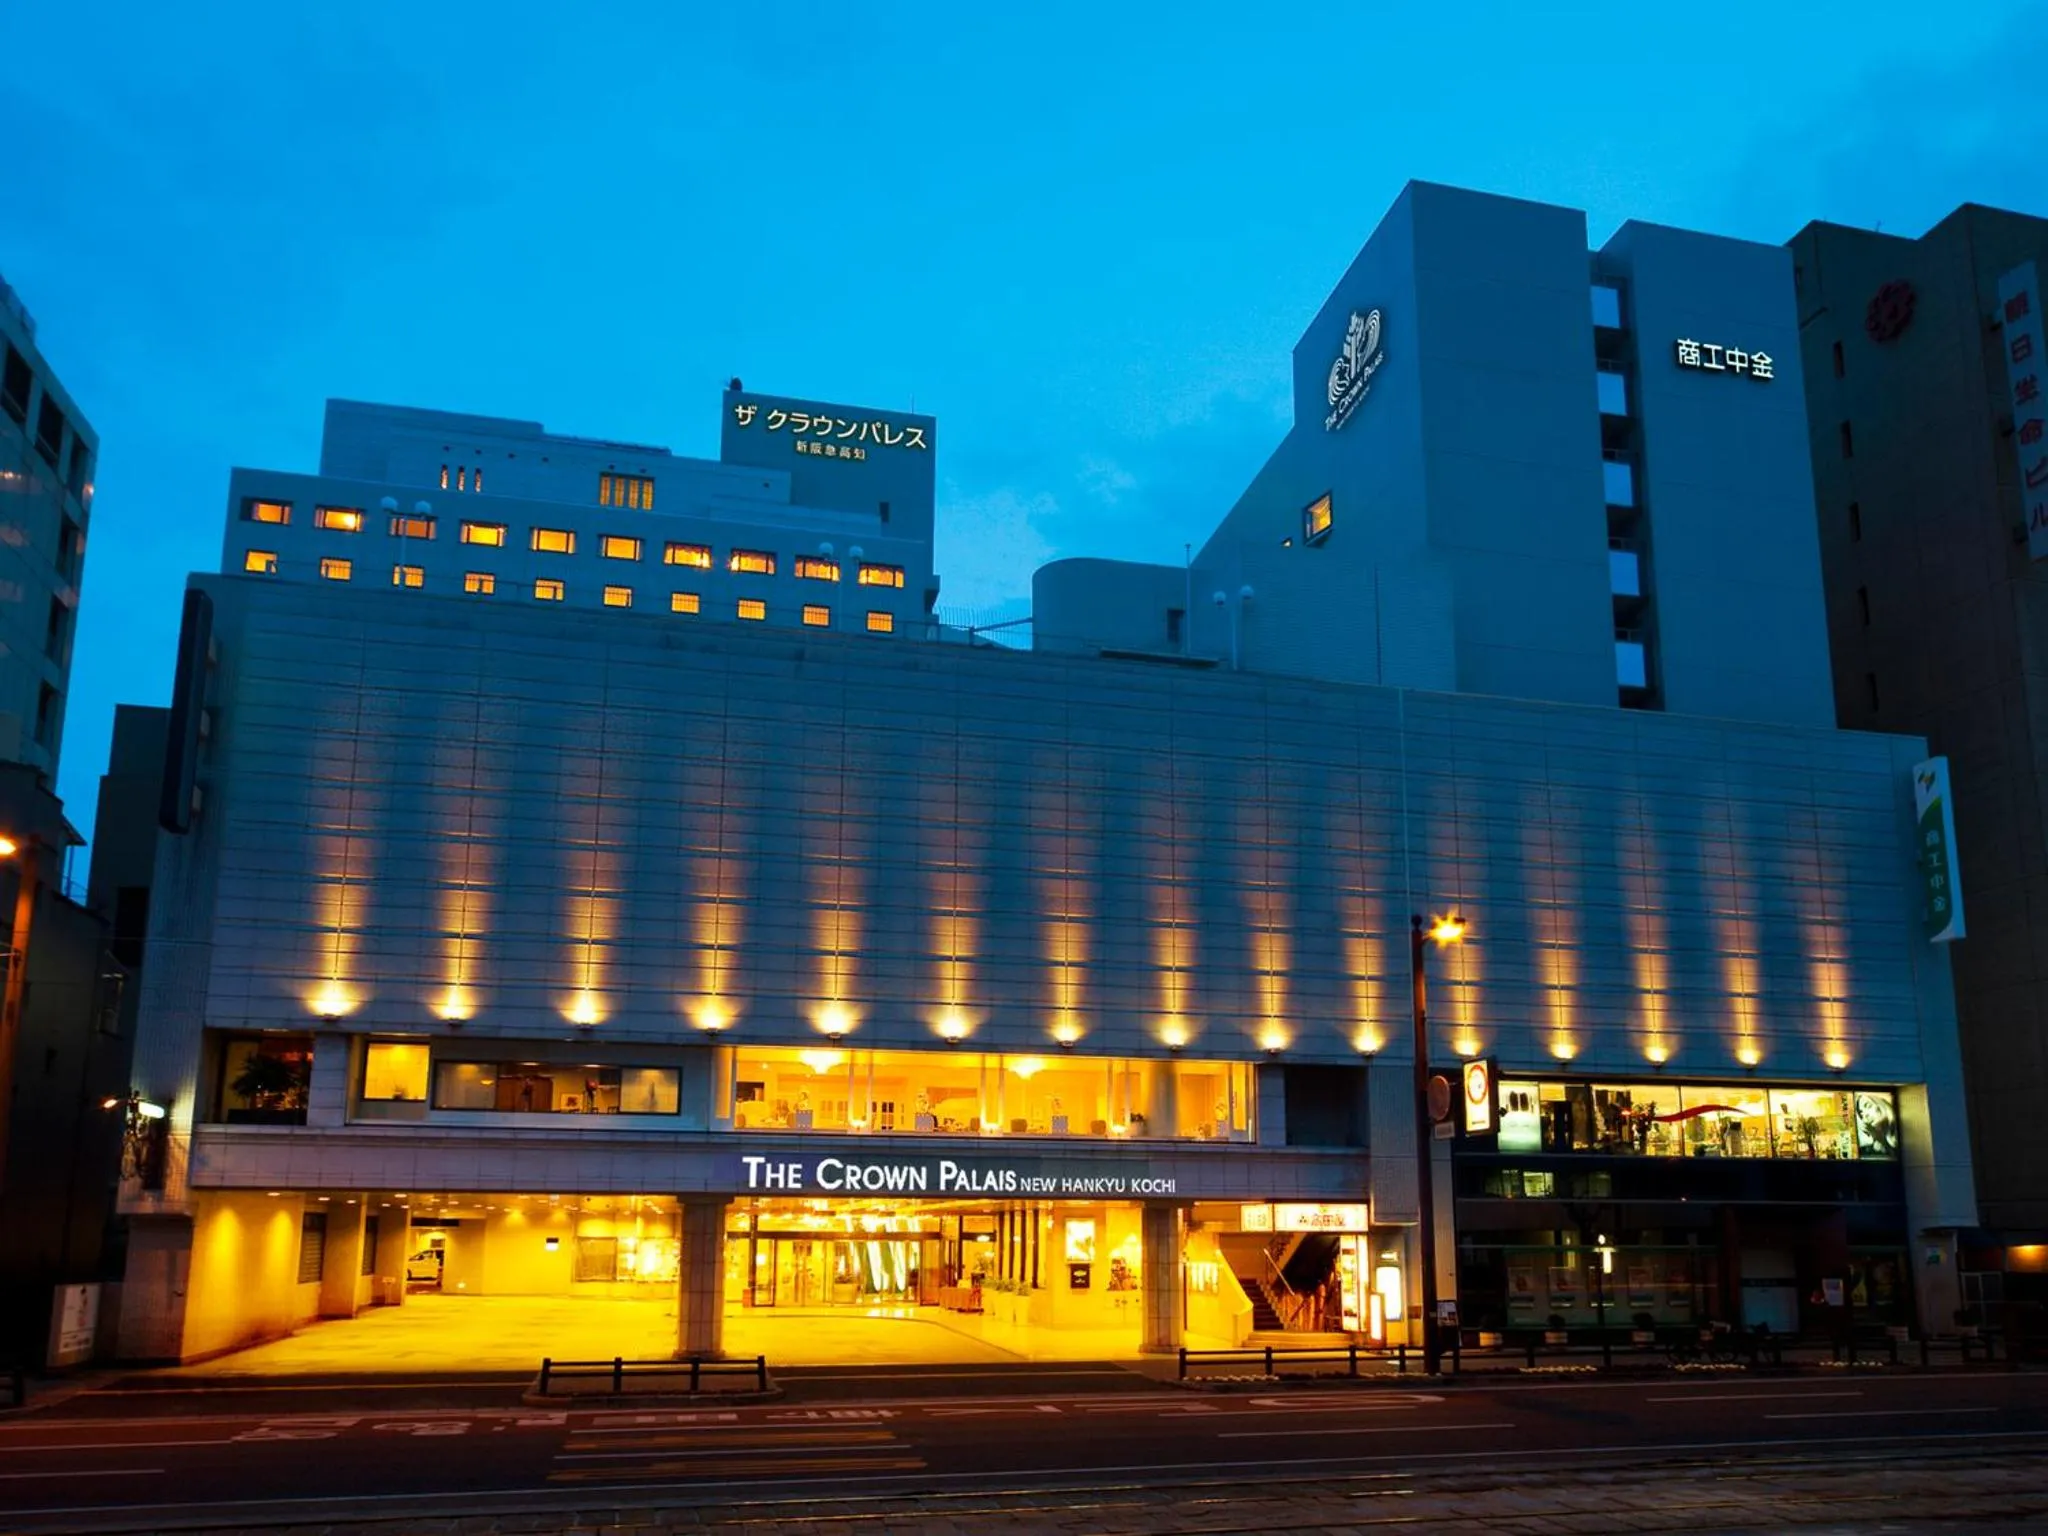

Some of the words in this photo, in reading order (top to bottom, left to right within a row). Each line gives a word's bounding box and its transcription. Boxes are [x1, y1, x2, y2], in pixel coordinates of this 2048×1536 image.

[1677, 338, 1774, 378] 商工中金
[735, 404, 757, 425] ザ
[767, 409, 926, 449] クラウンパレス
[741, 1156, 802, 1190] THE
[1020, 1178, 1057, 1193] NEW
[1062, 1178, 1125, 1193] HANKYU
[1131, 1179, 1175, 1194] KOCHI
